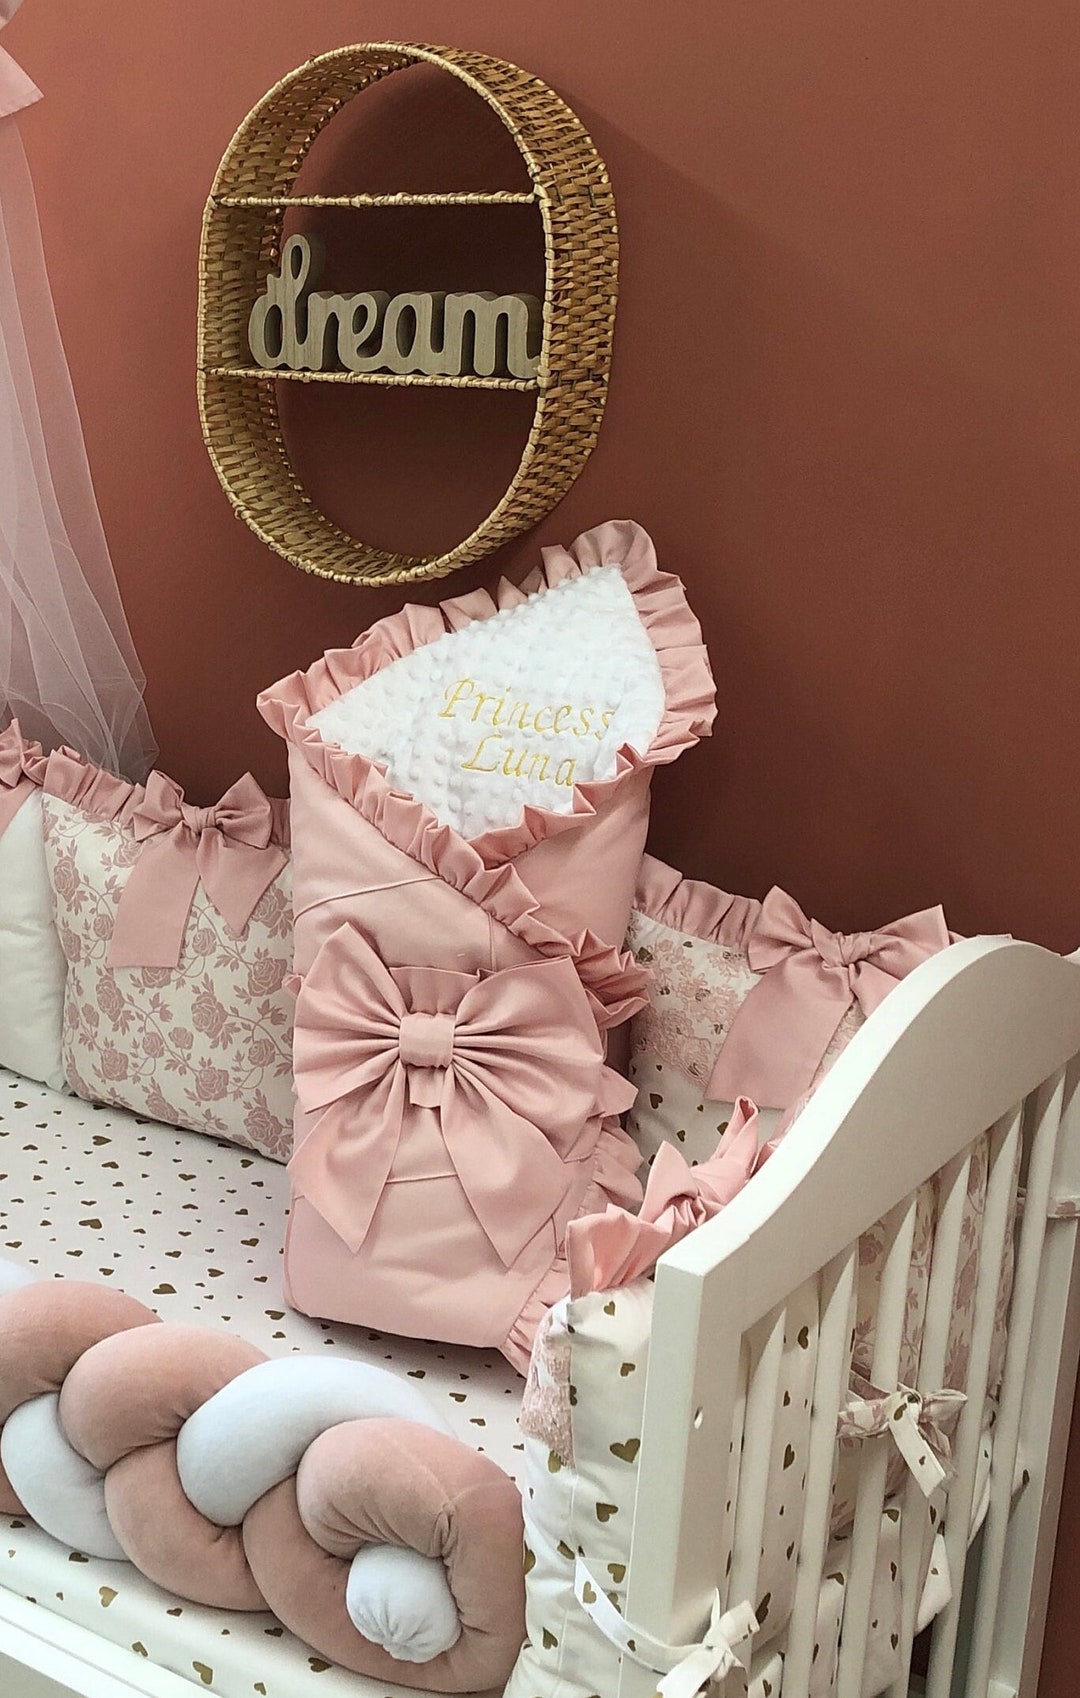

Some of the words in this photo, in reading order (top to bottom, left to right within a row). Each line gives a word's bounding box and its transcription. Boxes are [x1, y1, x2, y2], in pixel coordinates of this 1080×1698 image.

[248, 234, 541, 379] dream
[437, 677, 616, 741] Princess
[460, 732, 577, 787] Luna
